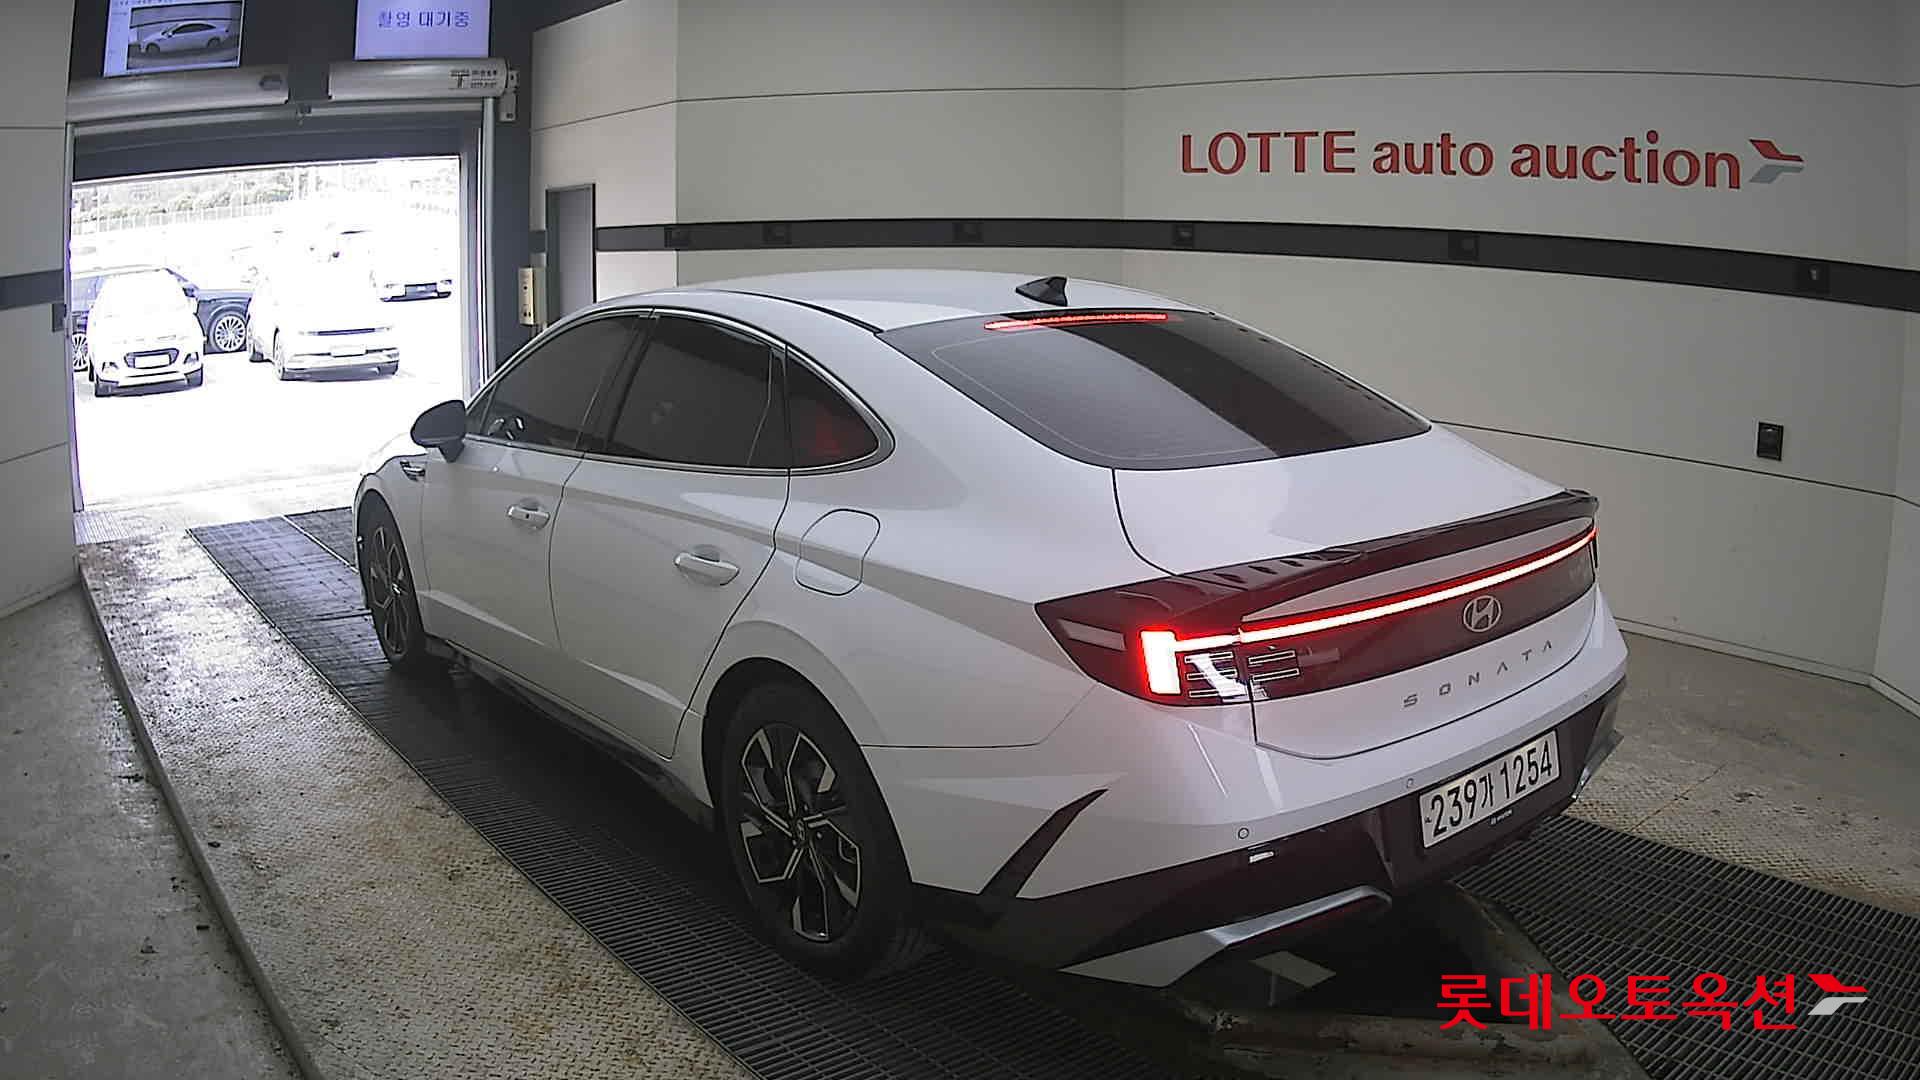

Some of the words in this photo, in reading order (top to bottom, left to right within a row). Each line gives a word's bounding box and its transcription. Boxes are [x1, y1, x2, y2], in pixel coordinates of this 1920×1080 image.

[417, 11, 470, 28] 대기중
[1181, 130, 1358, 174] LOTTE
[1373, 132, 1494, 174] auto
[1512, 131, 1740, 189] auction
[1403, 639, 1554, 709] SONATA
[1430, 772, 1494, 838] 239가
[1499, 741, 1553, 800] 1254
